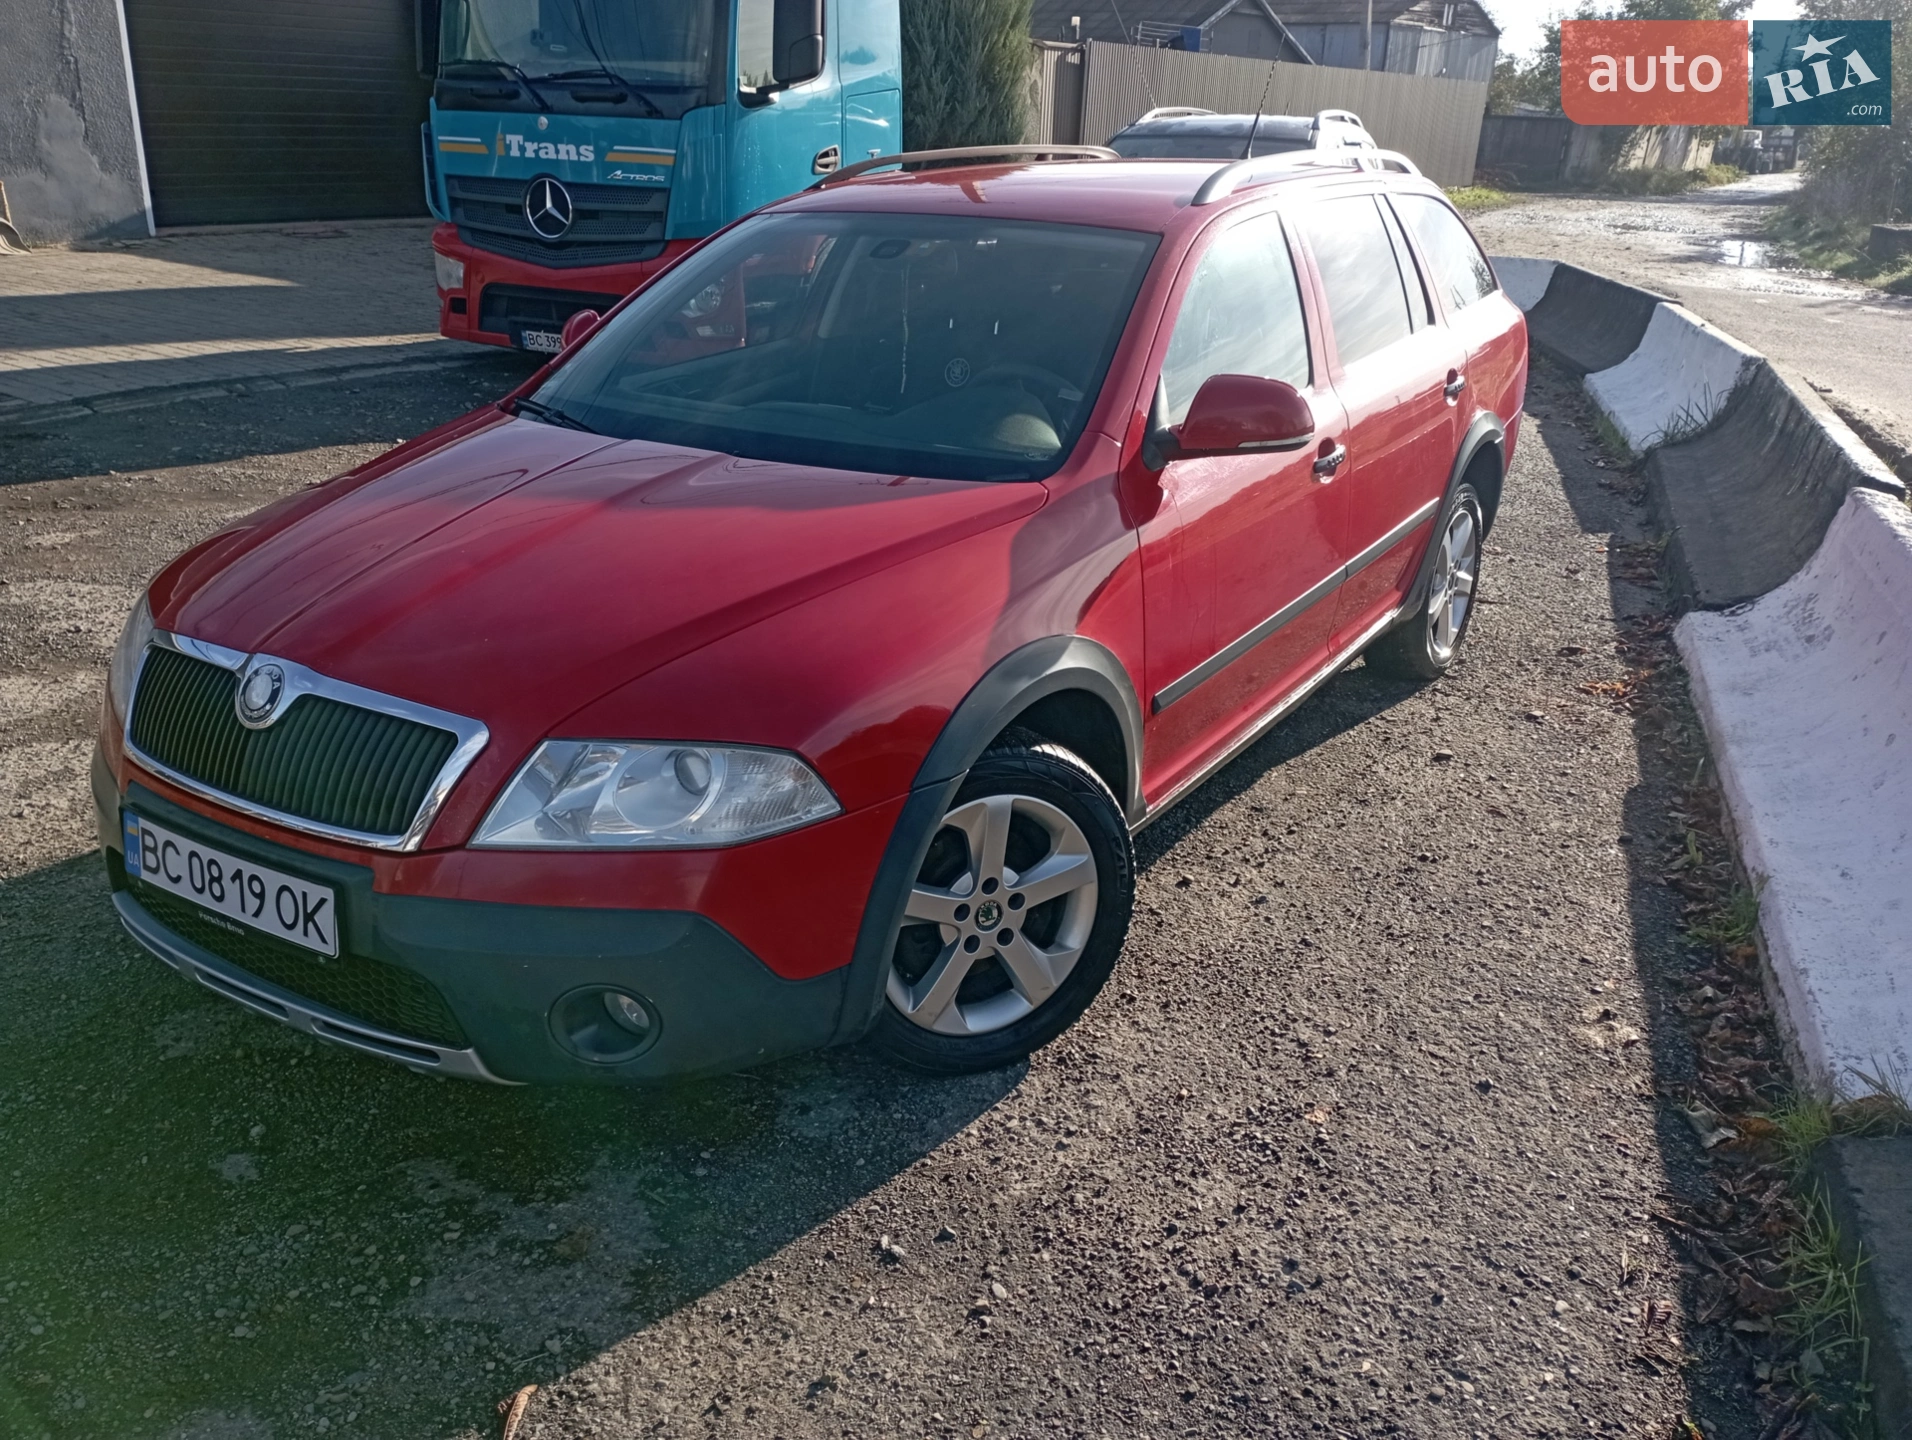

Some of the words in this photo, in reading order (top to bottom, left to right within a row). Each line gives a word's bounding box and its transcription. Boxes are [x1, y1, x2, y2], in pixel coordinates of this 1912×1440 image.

[527, 333, 543, 347] BC
[127, 851, 140, 868] UA
[140, 826, 182, 884] BC
[187, 850, 266, 919] 0819
[275, 884, 329, 946] OK
